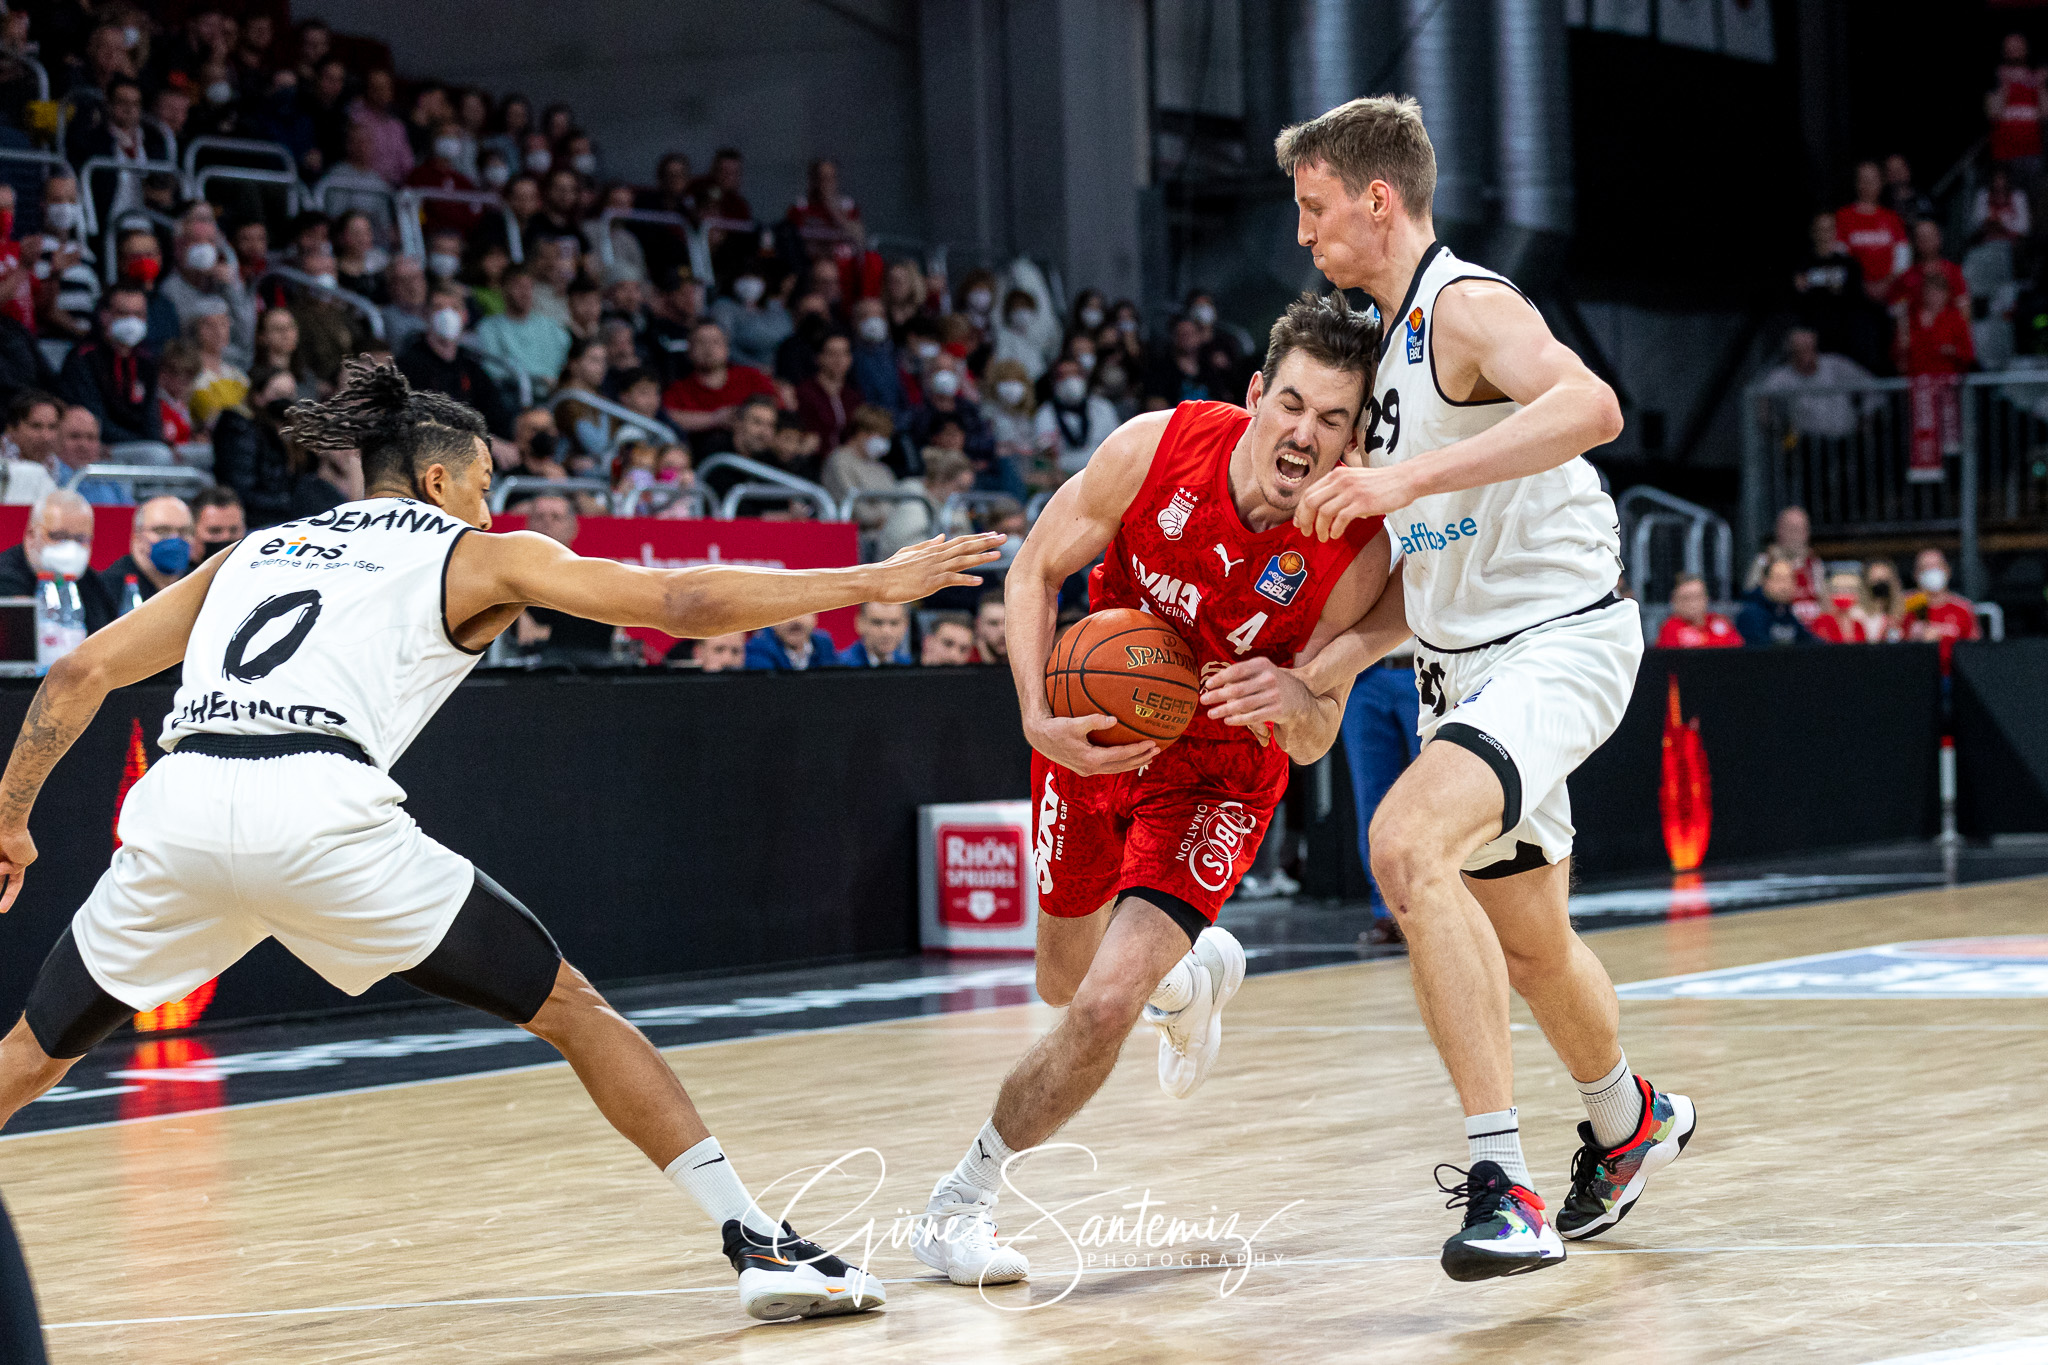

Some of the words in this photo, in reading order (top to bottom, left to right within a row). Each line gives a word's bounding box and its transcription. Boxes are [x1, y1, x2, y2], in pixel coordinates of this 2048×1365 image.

[1409, 347, 1422, 361] BBL
[1364, 388, 1400, 455] 29
[260, 536, 347, 560] eins
[305, 560, 319, 570] in
[1259, 579, 1287, 601] BBL
[222, 589, 323, 685] 0
[1226, 611, 1268, 655] 4
[1125, 645, 1198, 676] SPALDIN
[1132, 687, 1197, 715] LEGACY
[1478, 733, 1509, 760] adidas
[1060, 800, 1068, 820] car
[1058, 823, 1066, 832] a
[1175, 804, 1208, 862] OMATION
[1055, 834, 1065, 861] rent
